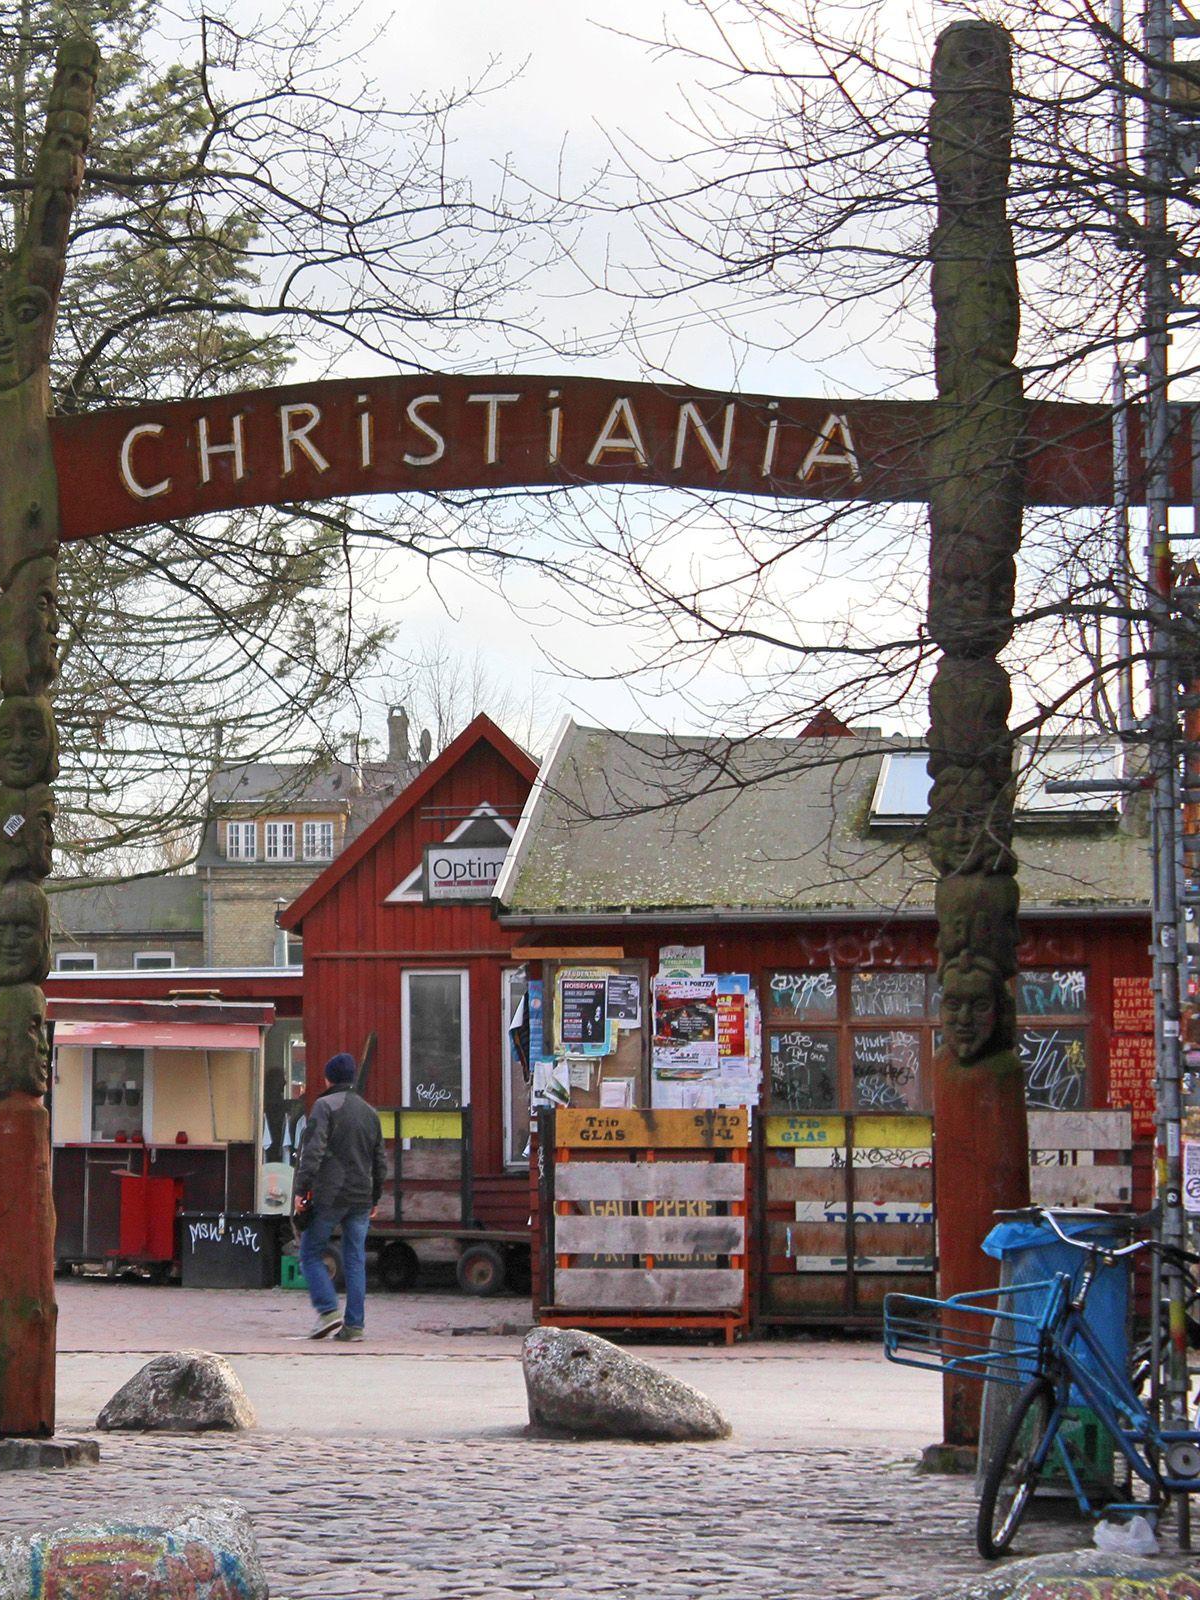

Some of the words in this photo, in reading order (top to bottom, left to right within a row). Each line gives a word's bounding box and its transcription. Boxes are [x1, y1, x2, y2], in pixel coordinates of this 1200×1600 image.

[585, 1116, 619, 1127] Trio
[788, 1118, 820, 1128] Trio
[580, 1129, 625, 1141] GLAS
[781, 1131, 827, 1142] GLAS
